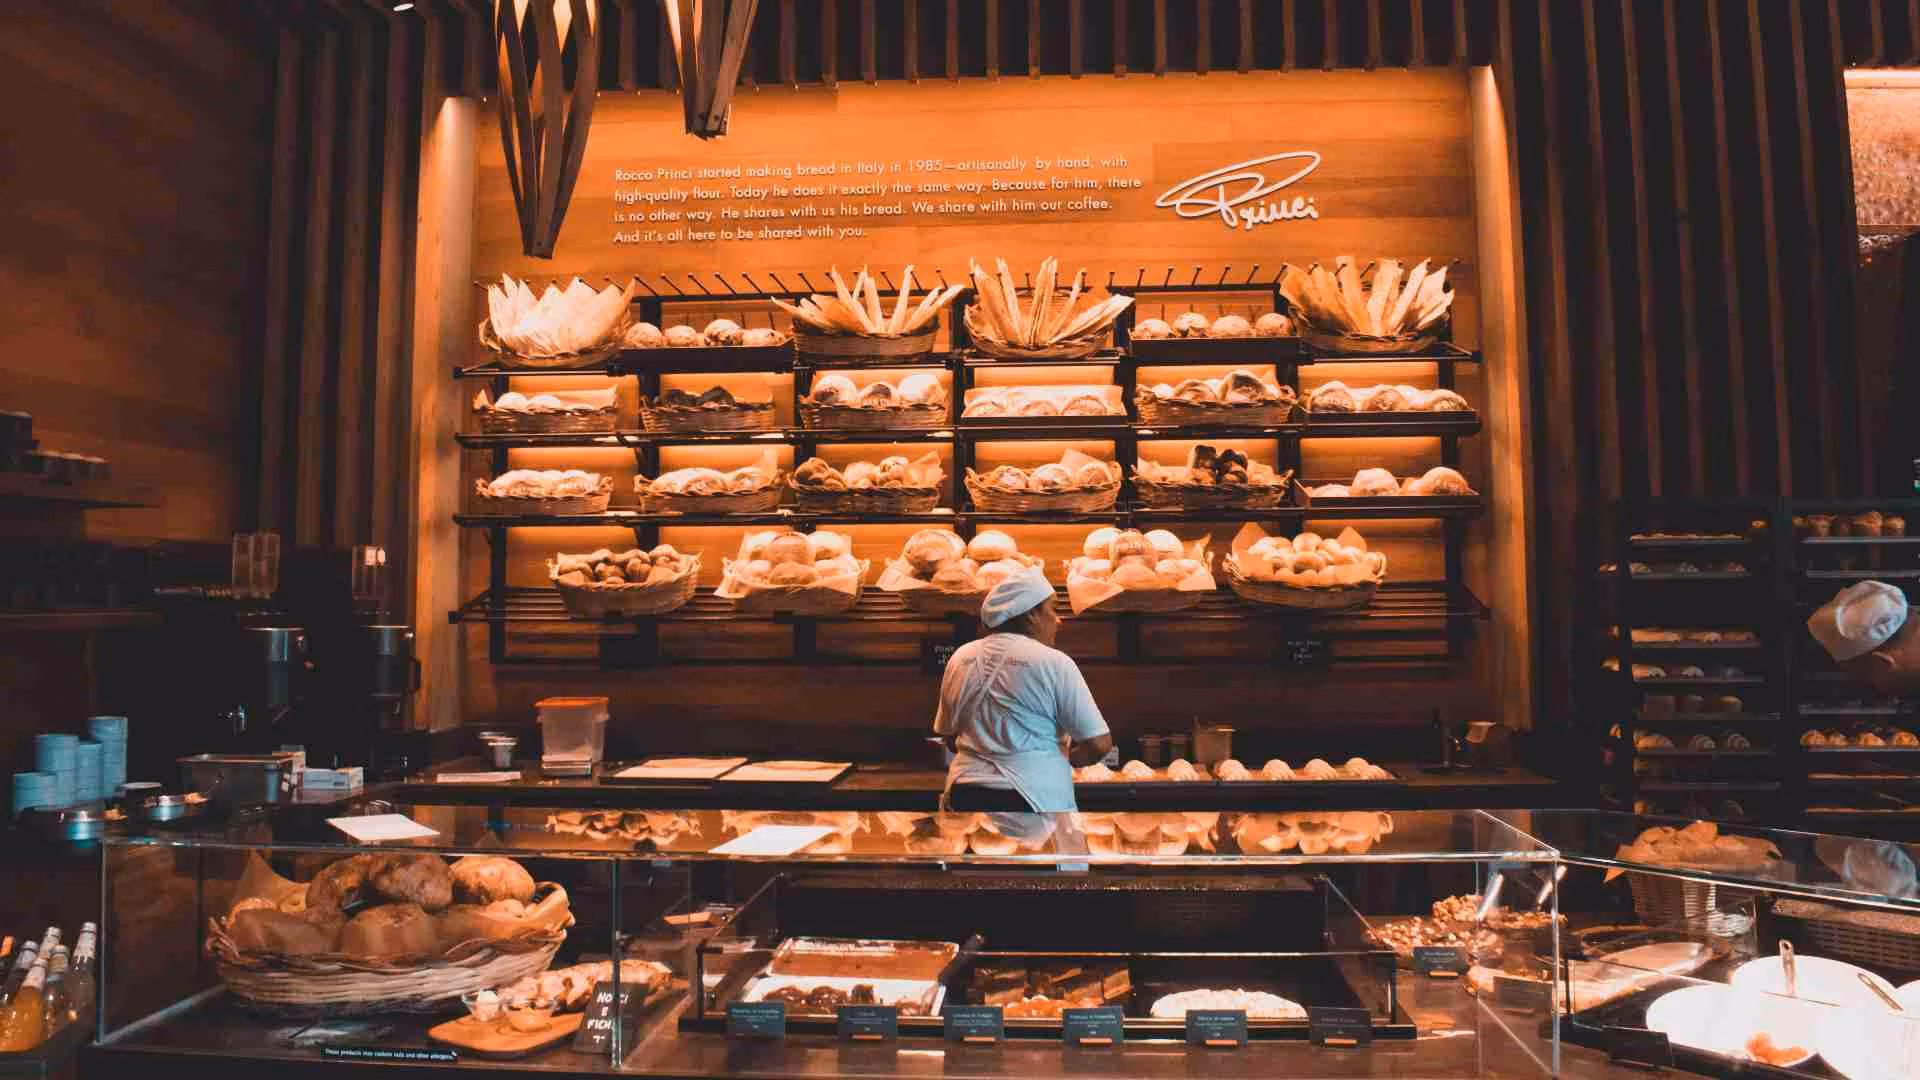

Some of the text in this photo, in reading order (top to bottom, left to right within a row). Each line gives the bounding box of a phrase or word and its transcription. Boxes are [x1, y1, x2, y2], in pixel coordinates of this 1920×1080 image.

[614, 168, 653, 181] Rocco
[657, 166, 692, 180] Princi
[697, 164, 741, 179] started
[745, 163, 792, 180] making
[796, 160, 836, 176] bread
[840, 160, 852, 175] in
[857, 159, 885, 175] Italy
[889, 158, 901, 173] in
[1034, 155, 1052, 172] by
[1100, 154, 1128, 169] with
[614, 187, 688, 205] high-quality
[728, 184, 768, 201] Today
[772, 184, 789, 198] he
[792, 184, 825, 197] does
[827, 183, 838, 196] it
[841, 179, 888, 197] exactly
[892, 179, 912, 193] the
[917, 183, 952, 194] same
[956, 183, 986, 196] way.
[991, 177, 1046, 192] Because
[1050, 176, 1069, 190] for
[1073, 176, 1103, 191] him,
[1107, 175, 1142, 190] there
[1155, 151, 1321, 230] Princi
[614, 196, 1113, 223] is no other way. He shares with us his bread. We share with him our coffee.
[614, 229, 640, 243] And
[667, 227, 684, 242] all
[686, 227, 717, 242] here
[720, 229, 734, 241] to
[736, 226, 753, 240] be
[758, 225, 803, 240] shared
[806, 224, 834, 238] with
[839, 227, 869, 240] you.
